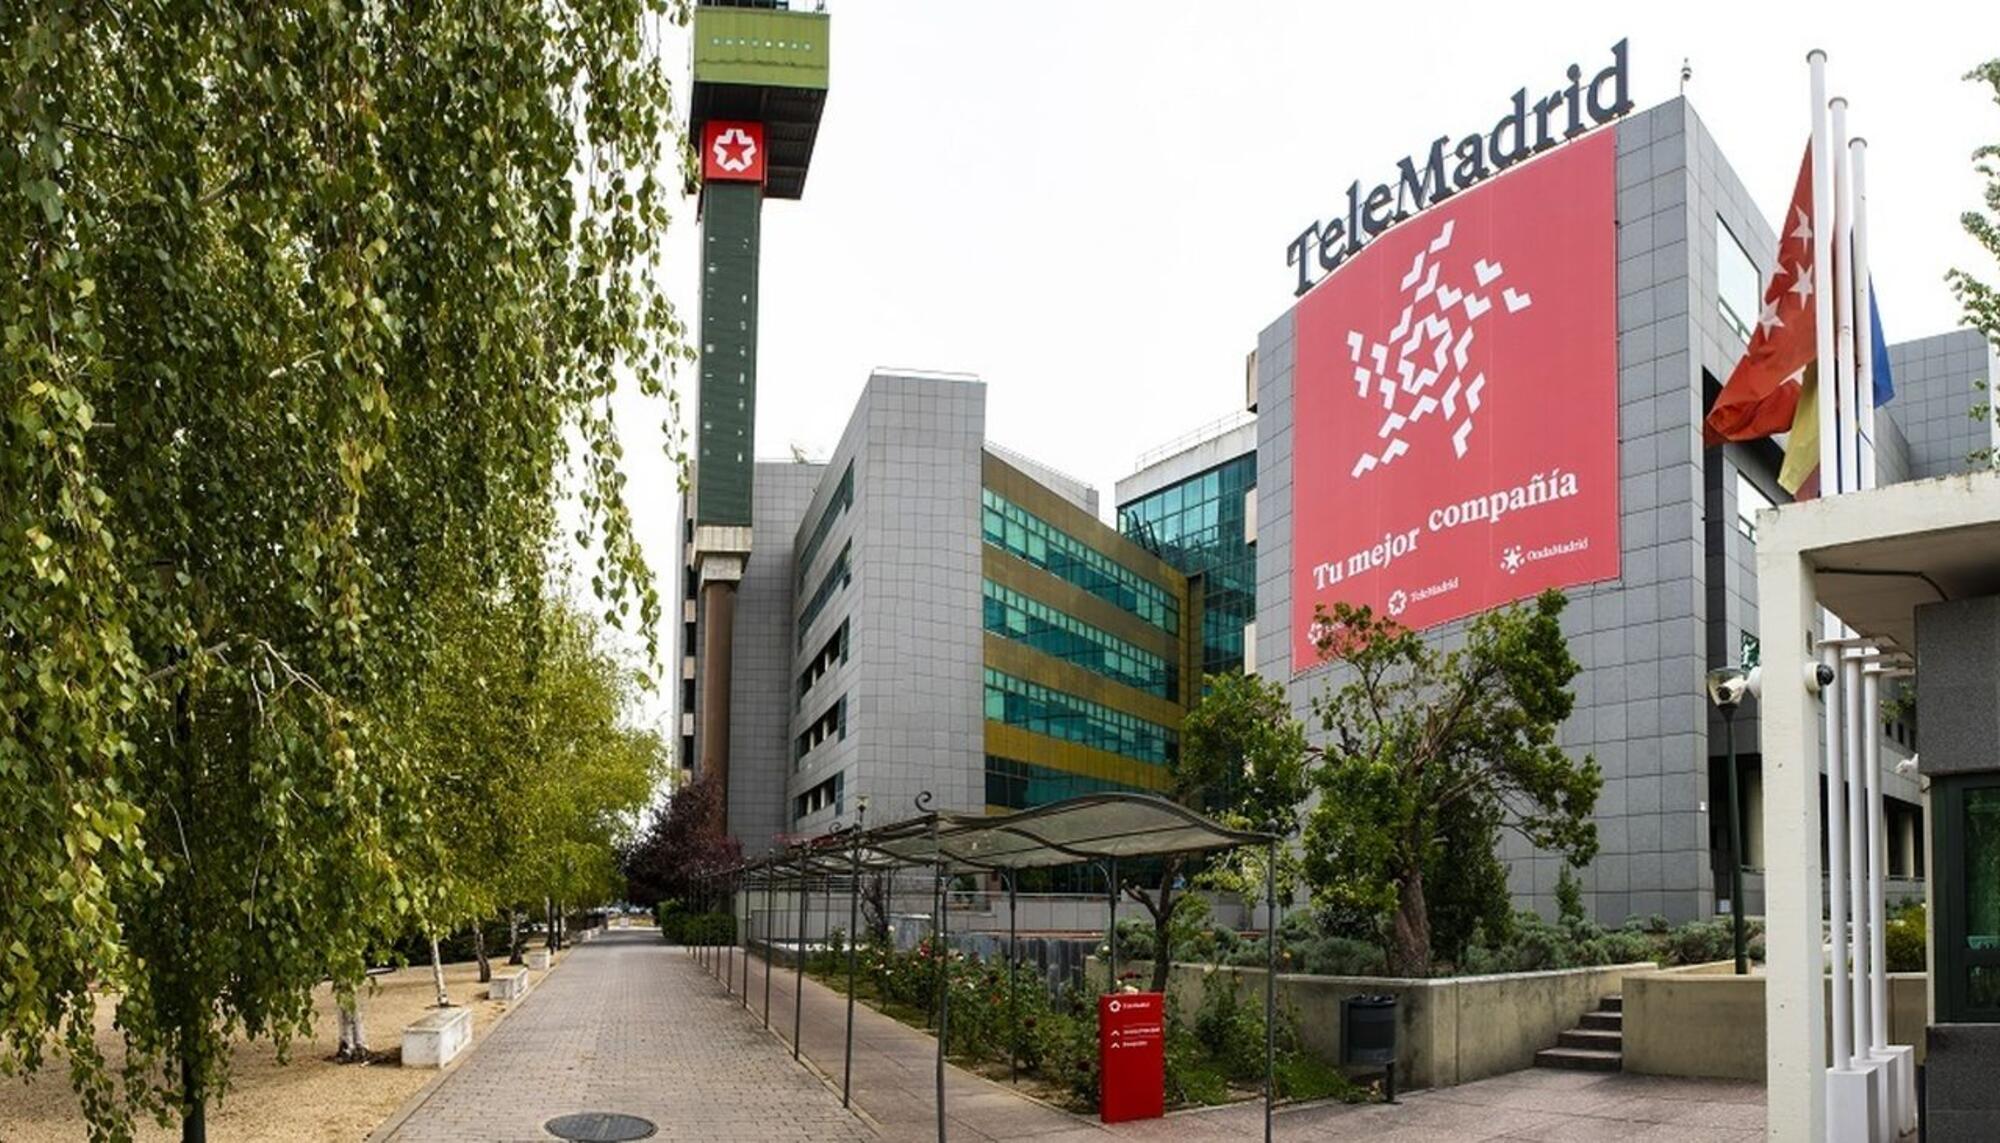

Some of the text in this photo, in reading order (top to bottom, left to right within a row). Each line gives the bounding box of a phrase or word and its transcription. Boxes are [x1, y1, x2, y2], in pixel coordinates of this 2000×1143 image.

[1286, 37, 1635, 298] TeleMadrid
[1313, 468, 1578, 591] Tu mejor compañía
